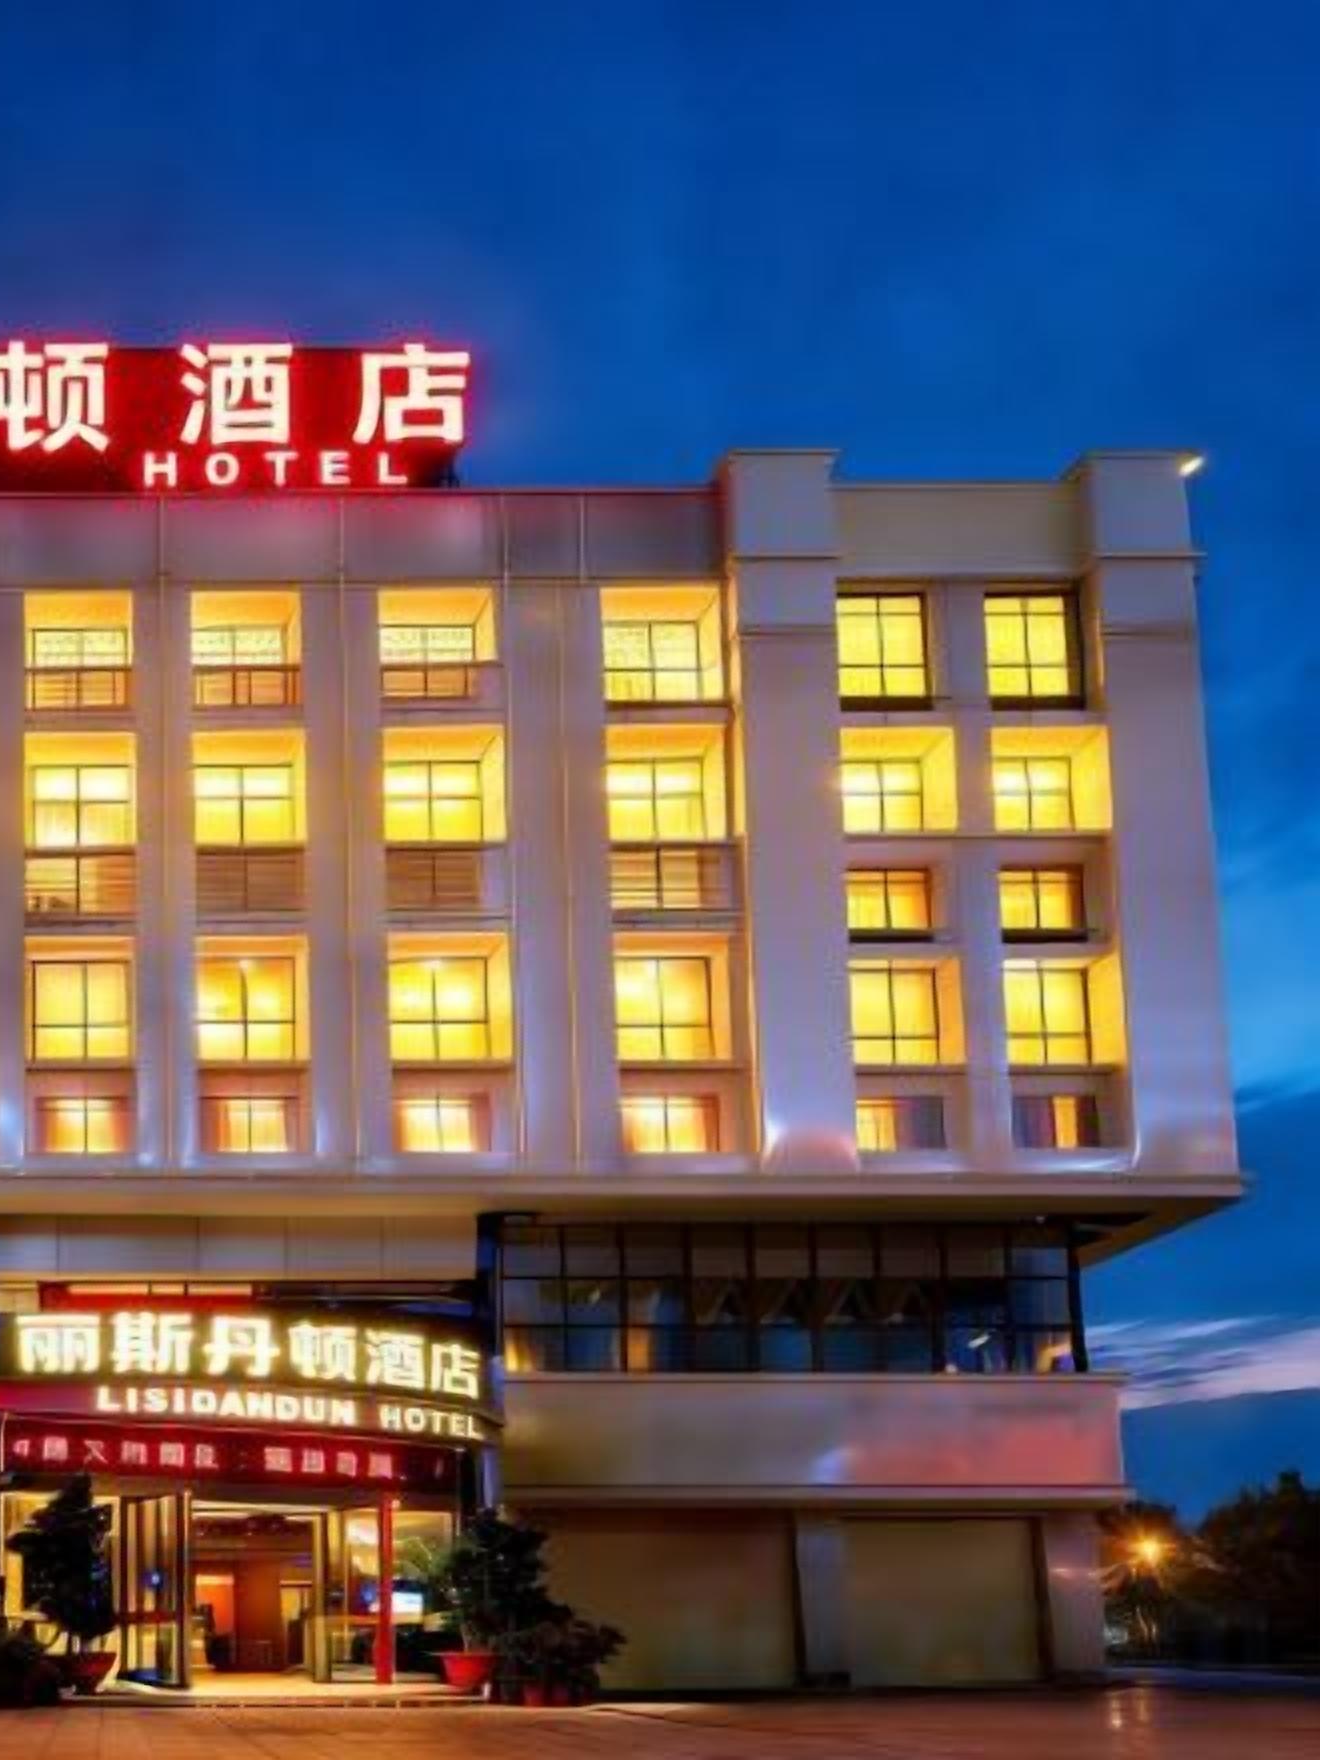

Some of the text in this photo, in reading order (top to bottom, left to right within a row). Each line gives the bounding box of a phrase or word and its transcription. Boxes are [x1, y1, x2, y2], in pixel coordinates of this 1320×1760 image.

[143, 449, 409, 487] HOTEL
[16, 1312, 479, 1397] 丽斯丹顿酒店
[96, 1384, 484, 1440] LISIDANDUN HOTEL
